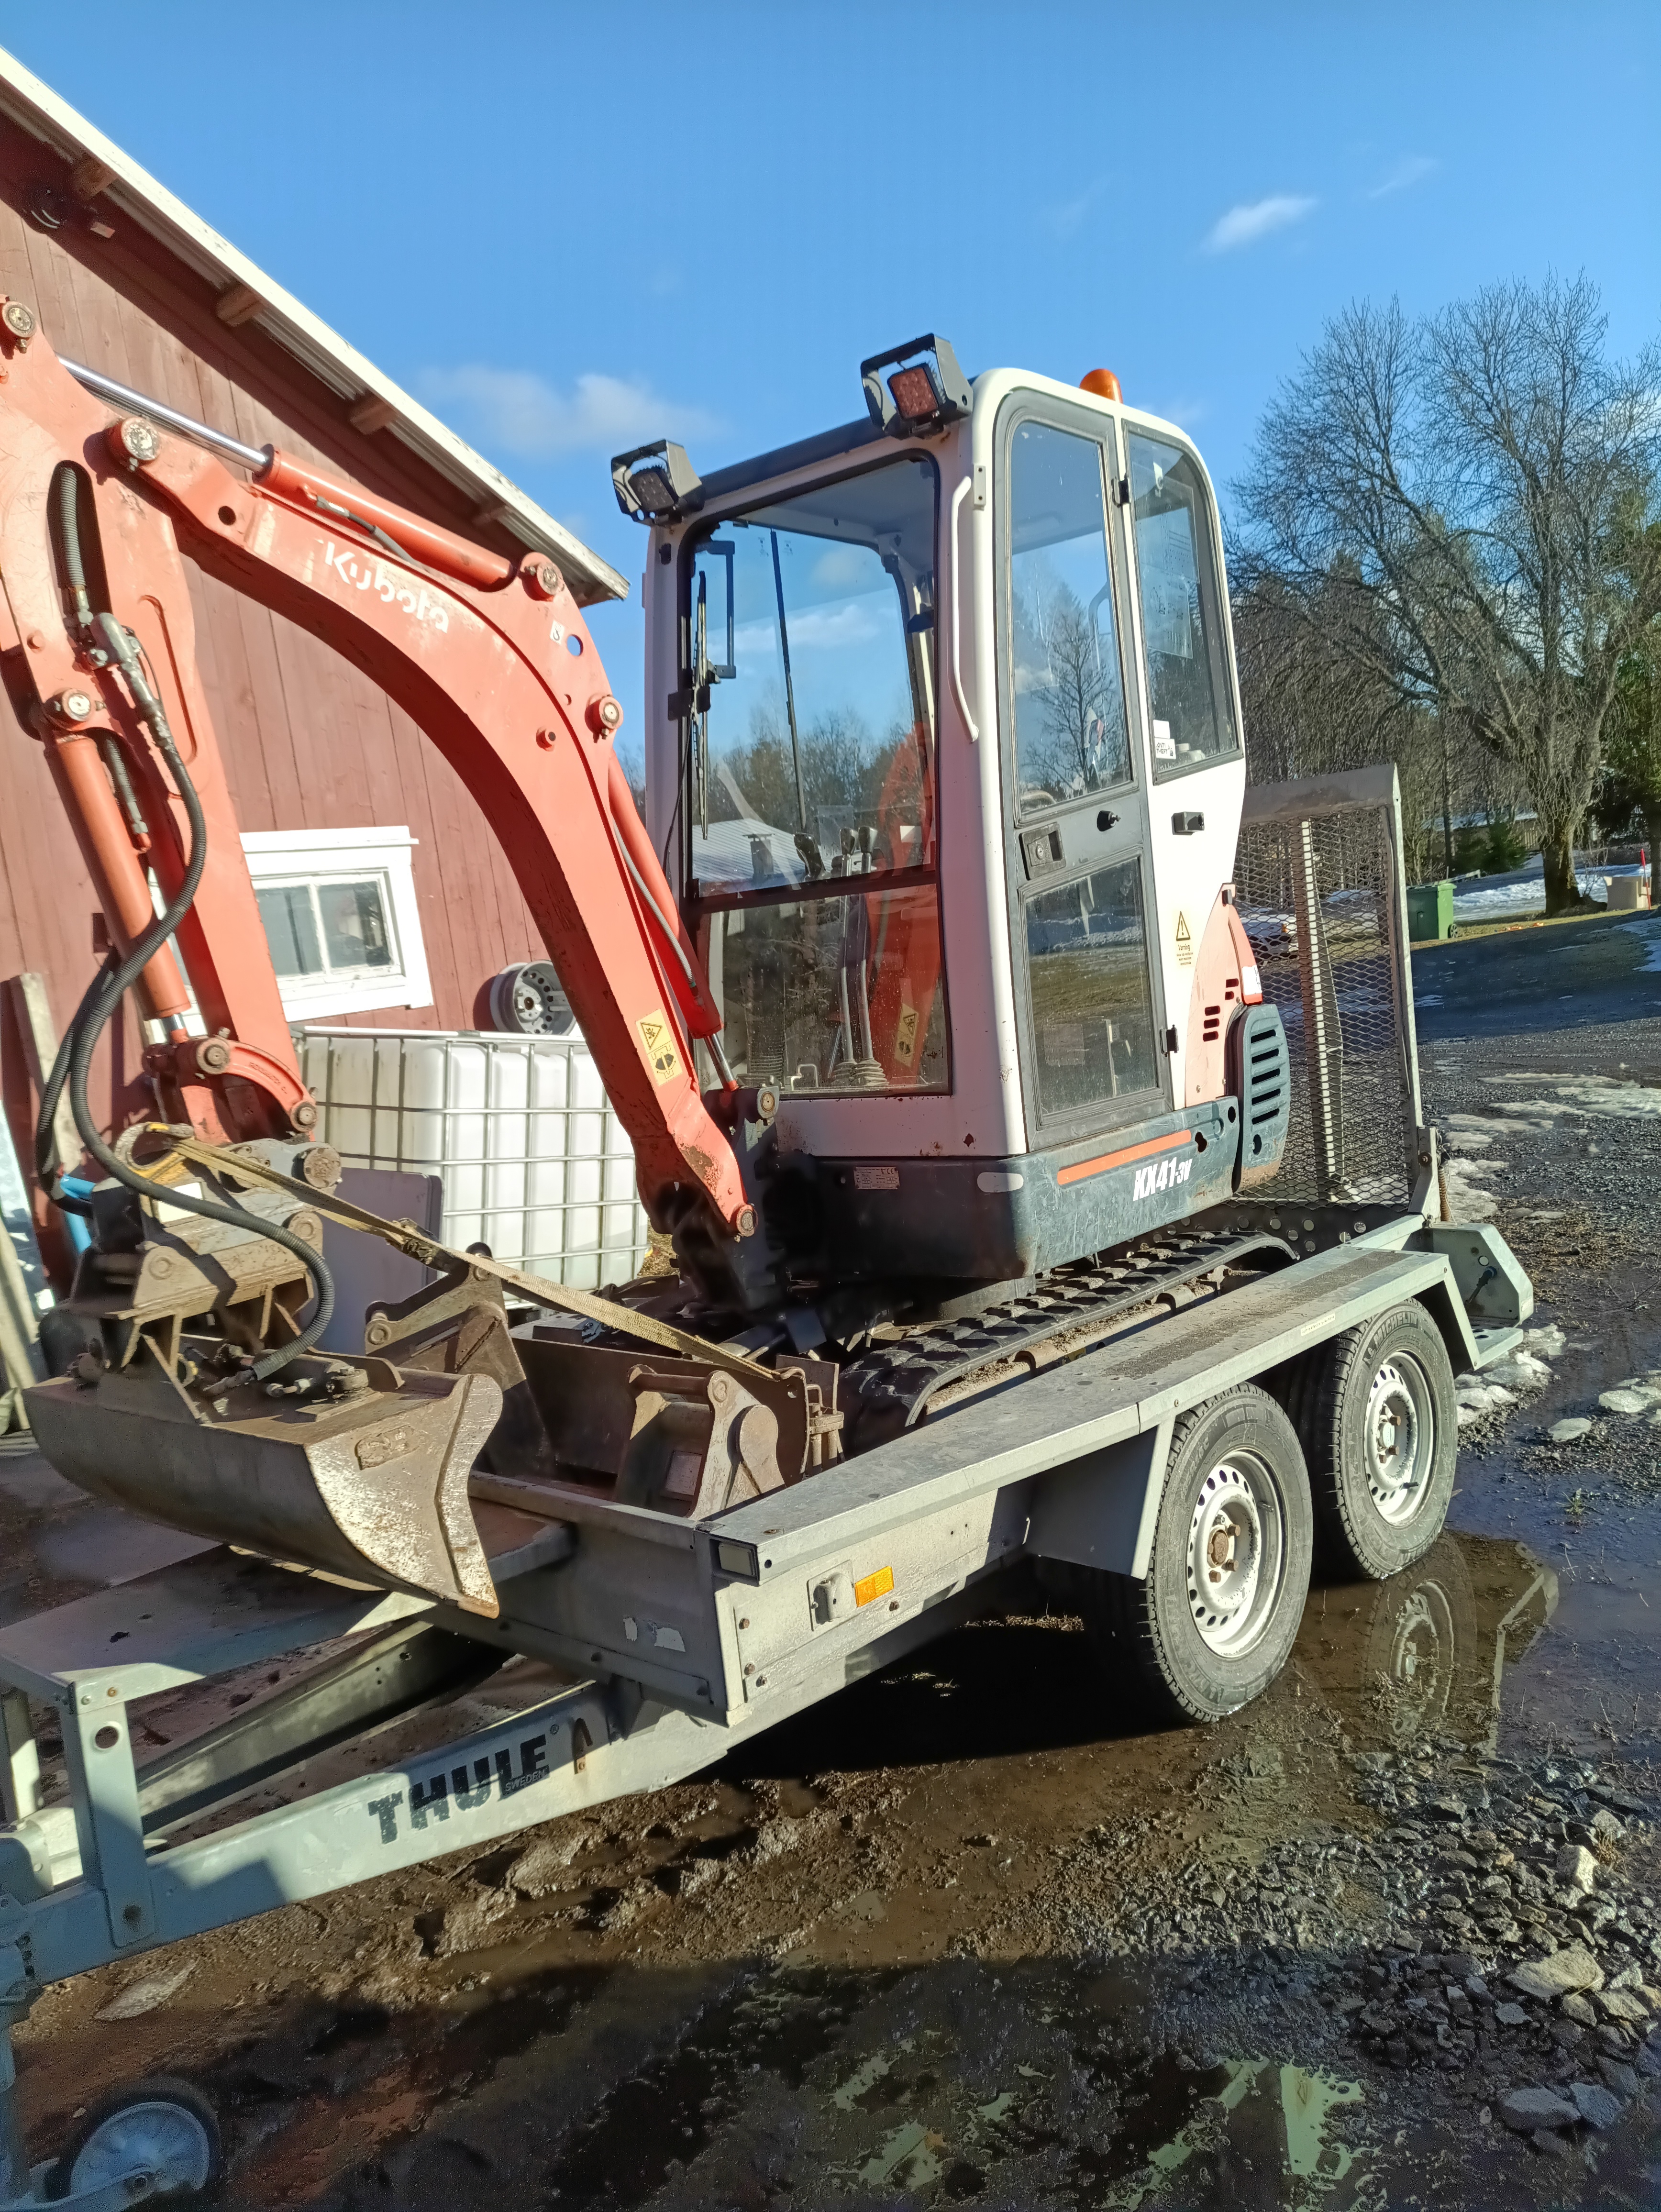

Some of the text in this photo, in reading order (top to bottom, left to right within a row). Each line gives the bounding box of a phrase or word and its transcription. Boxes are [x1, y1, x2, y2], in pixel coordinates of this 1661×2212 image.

[325, 541, 449, 633] Kubota
[1178, 943, 1190, 951] Varning
[1132, 1156, 1193, 1202] KX41-3V
[1373, 1312, 1418, 1349] MICHELIN
[367, 1734, 550, 1845] THULE
[505, 1766, 548, 1792] SWEDEN
